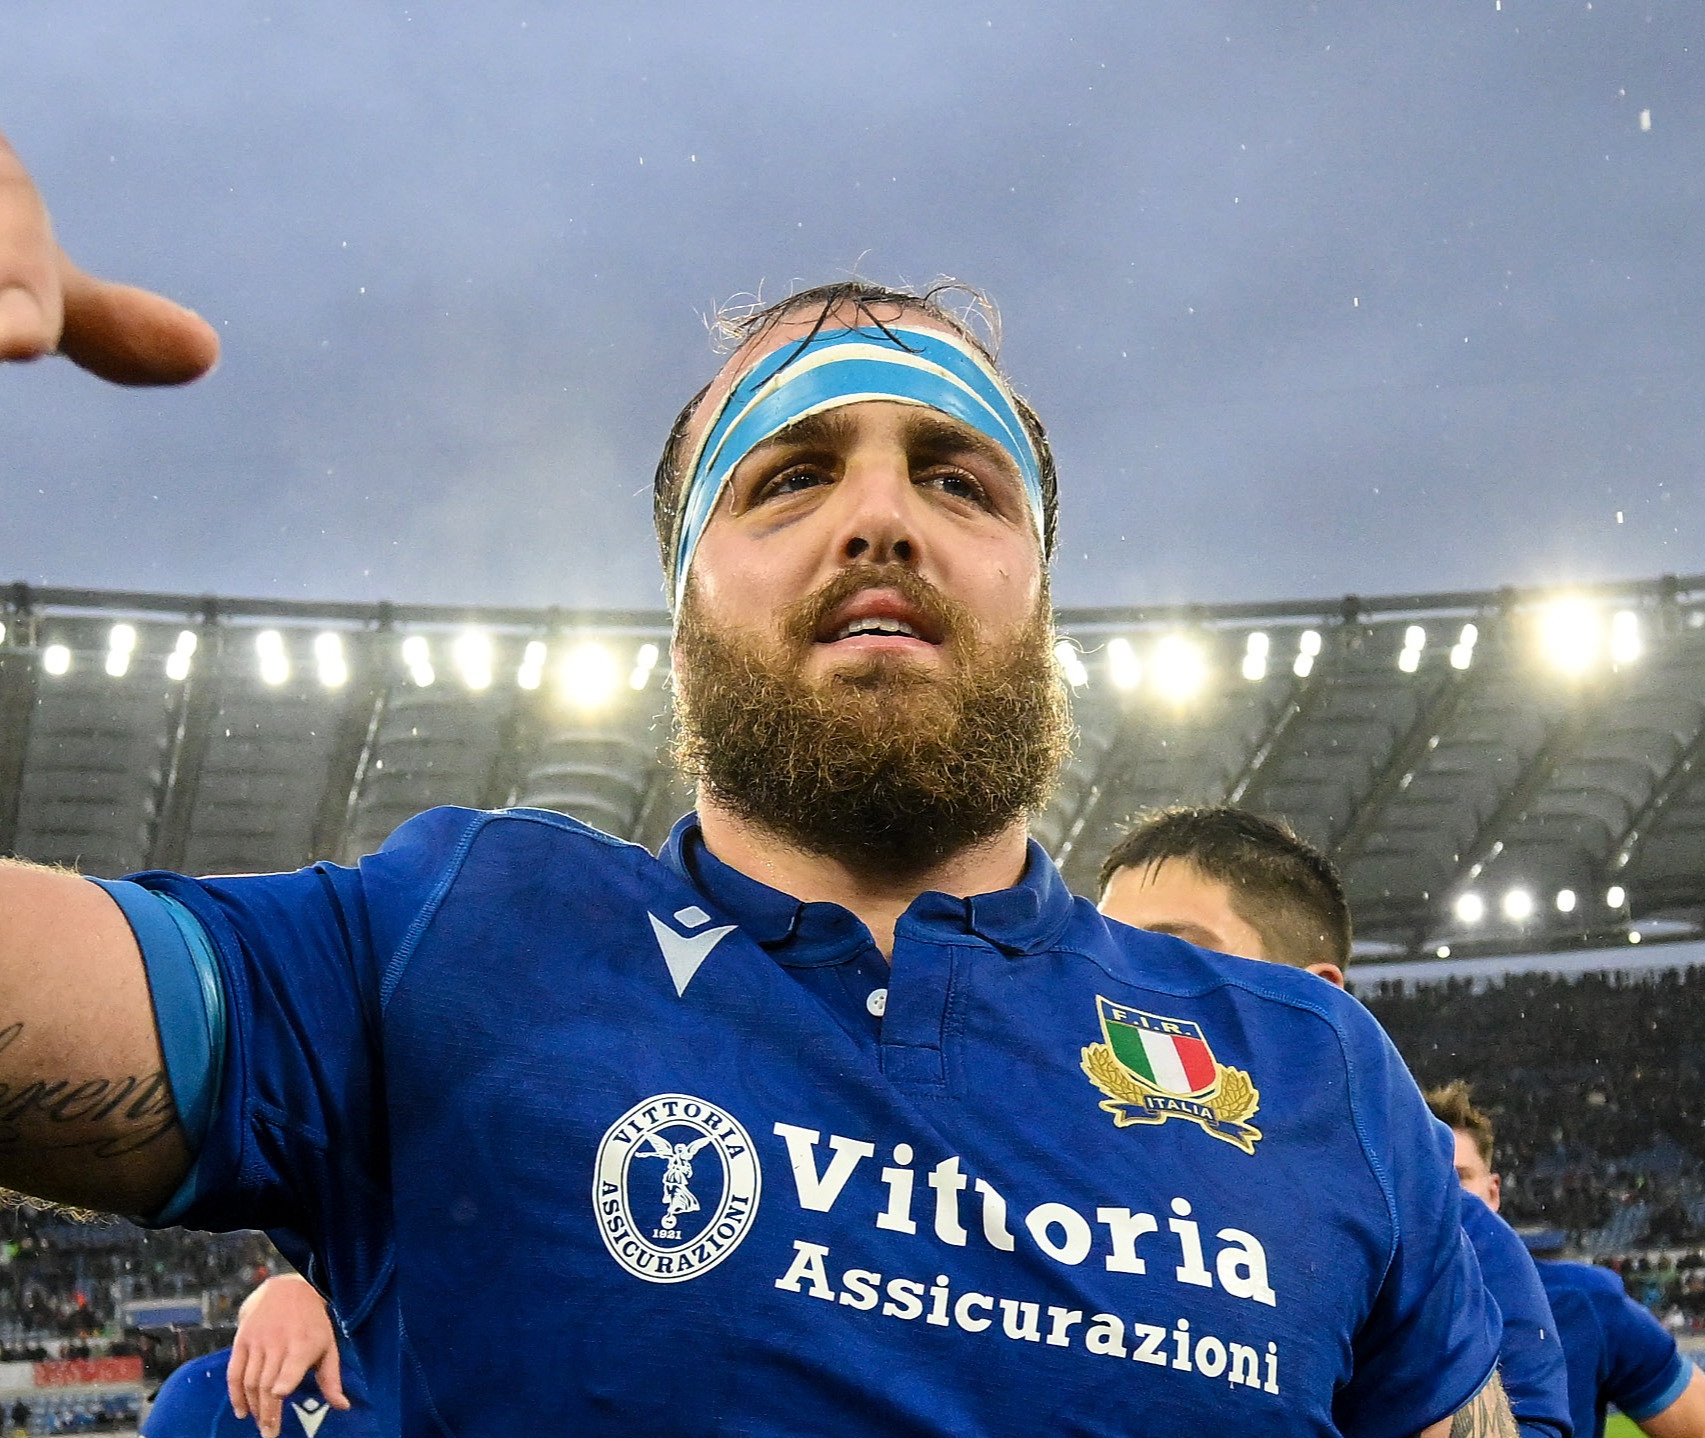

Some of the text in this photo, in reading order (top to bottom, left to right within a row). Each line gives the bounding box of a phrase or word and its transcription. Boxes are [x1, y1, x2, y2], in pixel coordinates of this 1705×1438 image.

[1112, 1008, 1192, 1036] F.I.R.
[613, 1101, 746, 1160] VITTORIA
[1148, 1097, 1214, 1121] ITALIA
[601, 1180, 749, 1274] ASSICURAZIONI
[652, 1228, 682, 1240] 1921
[773, 1122, 1277, 1308] Vittoria
[774, 1240, 1280, 1396] Assicurazioni
